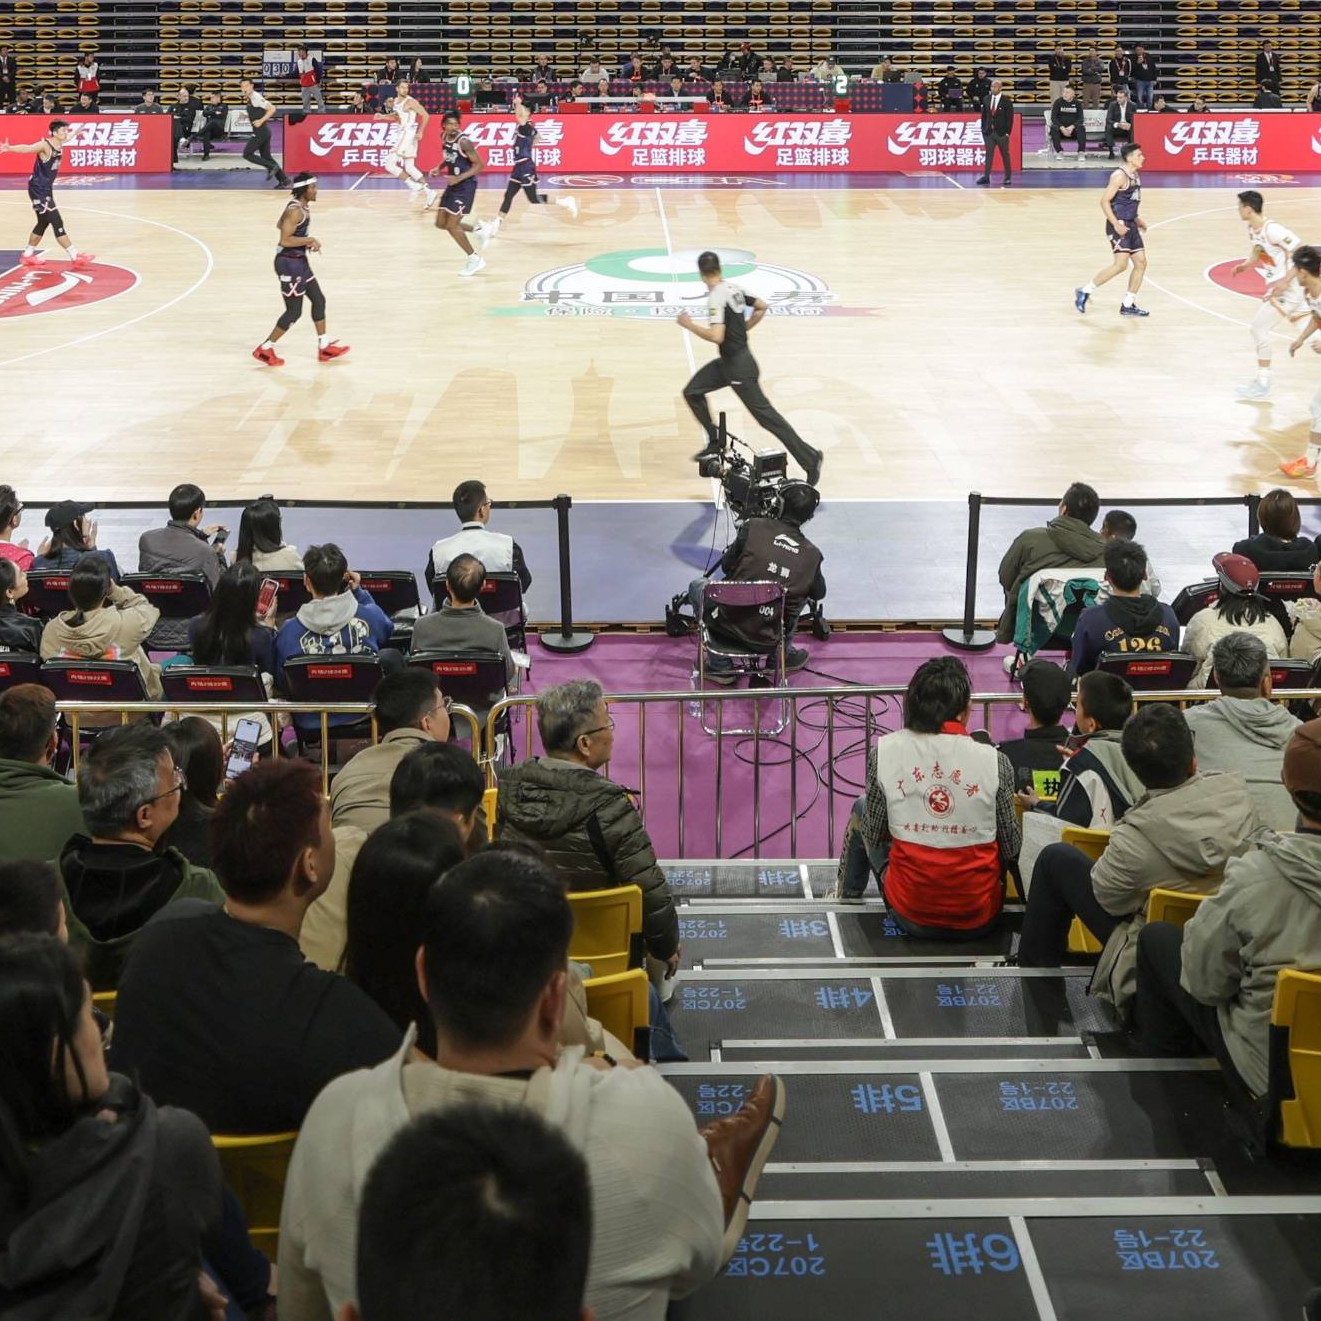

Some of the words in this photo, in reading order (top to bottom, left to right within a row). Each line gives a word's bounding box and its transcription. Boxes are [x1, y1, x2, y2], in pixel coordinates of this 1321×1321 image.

[600, 120, 709, 156] 红双喜
[744, 120, 852, 157] 红双喜
[1164, 119, 1261, 156] 红双喜
[70, 150, 137, 168] 羽球器材
[632, 148, 706, 167] 足篮排球
[776, 148, 850, 167] 足篮排球
[1192, 148, 1259, 166] 乒乓器材
[773, 540, 800, 554] LI-NING
[758, 870, 801, 886] 2排
[779, 919, 829, 939] 3排
[681, 984, 743, 998] 1-22号
[814, 986, 874, 1010] 4排
[936, 982, 998, 996] 22-1号
[681, 998, 747, 1011] 207C区
[937, 995, 1001, 1009] 207B区
[697, 1082, 753, 1098] -22号
[851, 1082, 923, 1115] 5排
[998, 1081, 1074, 1097] 22-1号
[1000, 1096, 1078, 1112] 207B区
[1112, 1229, 1205, 1250] 22-1号
[926, 1231, 1022, 1278] 6排
[1121, 1249, 1221, 1270] 207B区
[724, 1256, 827, 1279] 207C区
